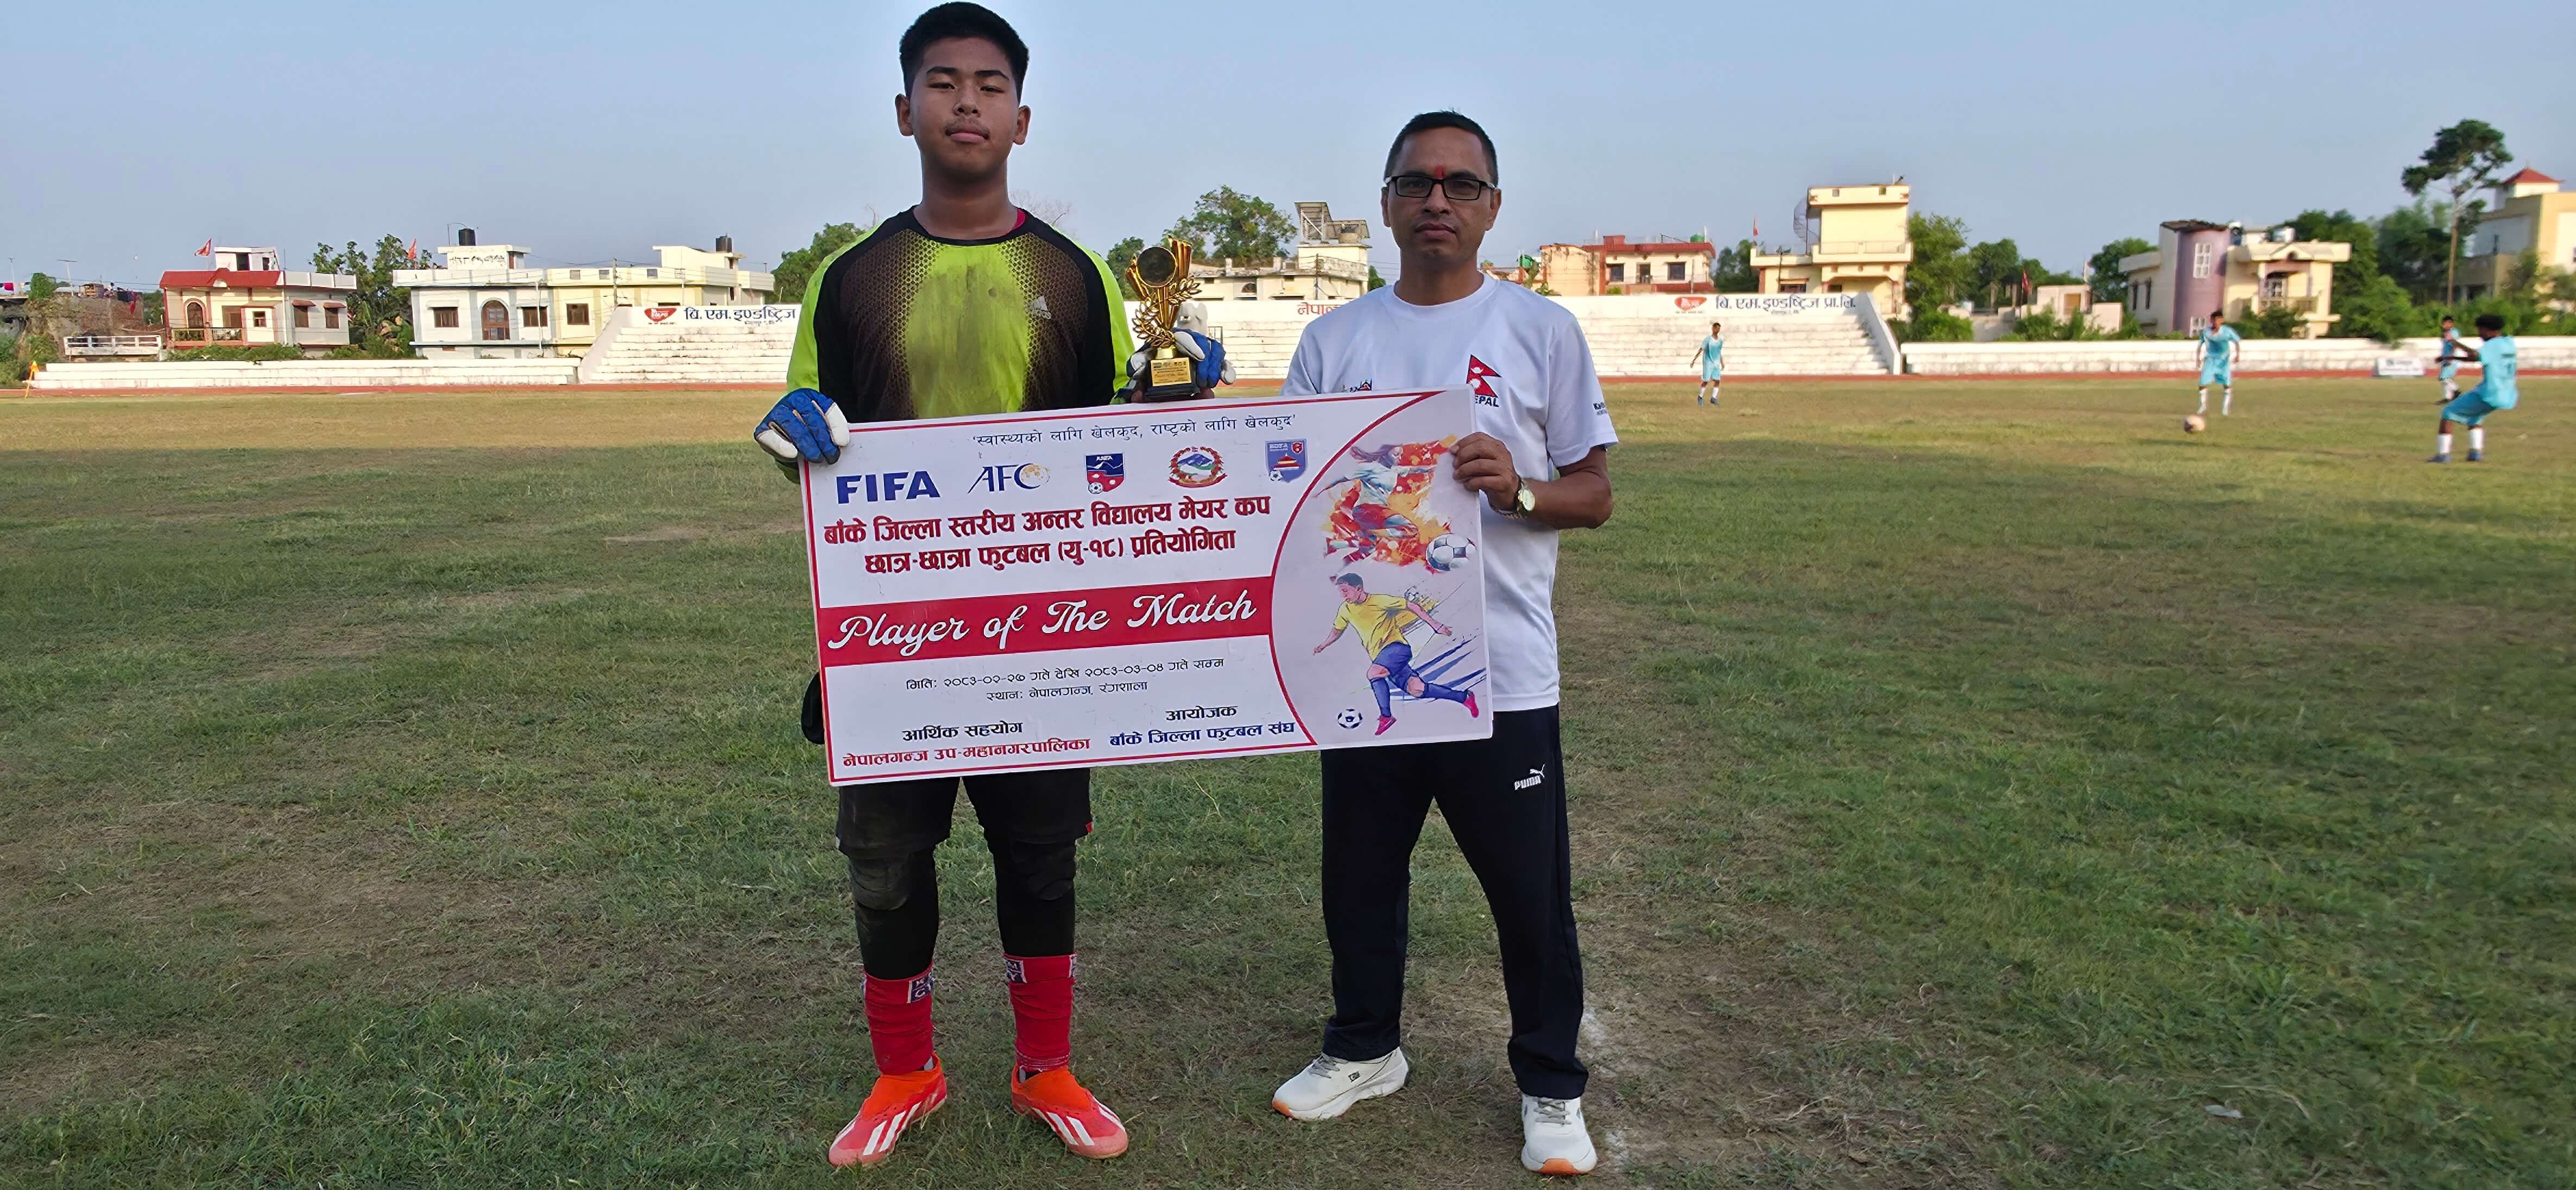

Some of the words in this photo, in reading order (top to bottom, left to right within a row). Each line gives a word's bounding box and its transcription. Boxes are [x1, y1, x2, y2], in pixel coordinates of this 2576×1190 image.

[1475, 395, 1499, 407] EPAL
[1050, 427, 1083, 441] लागि
[1091, 425, 1142, 440] खेलकुद,
[1151, 419, 1197, 437] राष्ट्रको
[1204, 417, 1237, 431] लागि
[836, 471, 940, 504] FIFA
[968, 463, 1040, 494] AFC
[873, 515, 942, 541] जिल्ला
[948, 509, 1015, 537] स्तरीय
[1021, 509, 1085, 531] अन्तर
[1091, 501, 1172, 527] विद्यालय
[1178, 495, 1228, 520] मेयर
[1234, 496, 1271, 516] कप
[977, 543, 1051, 571] फुटबल
[1057, 537, 1123, 565] (यु-१८)
[1130, 525, 1236, 559] प्रतियोगिता
[828, 613, 970, 657] Player
[983, 605, 1028, 650] of
[1041, 599, 1111, 634] The
[1126, 590, 1258, 629] Match
[906, 678, 937, 689] मिति:
[1030, 668, 1050, 680] गते
[1055, 667, 1079, 679] देखि
[1167, 659, 1189, 671] गते
[1193, 659, 1224, 668] सम्म
[987, 691, 1023, 701] स्थान:
[1099, 681, 1147, 692] रंगशाला
[1165, 705, 1238, 721] आयोजक
[902, 725, 959, 741] आर्थिक
[964, 720, 1023, 737] सहयोग
[1148, 729, 1202, 744] जिल्ला
[1207, 725, 1263, 742] फुटबल
[1268, 721, 1296, 734] संघ
[843, 750, 929, 766] नेपालगन्ज
